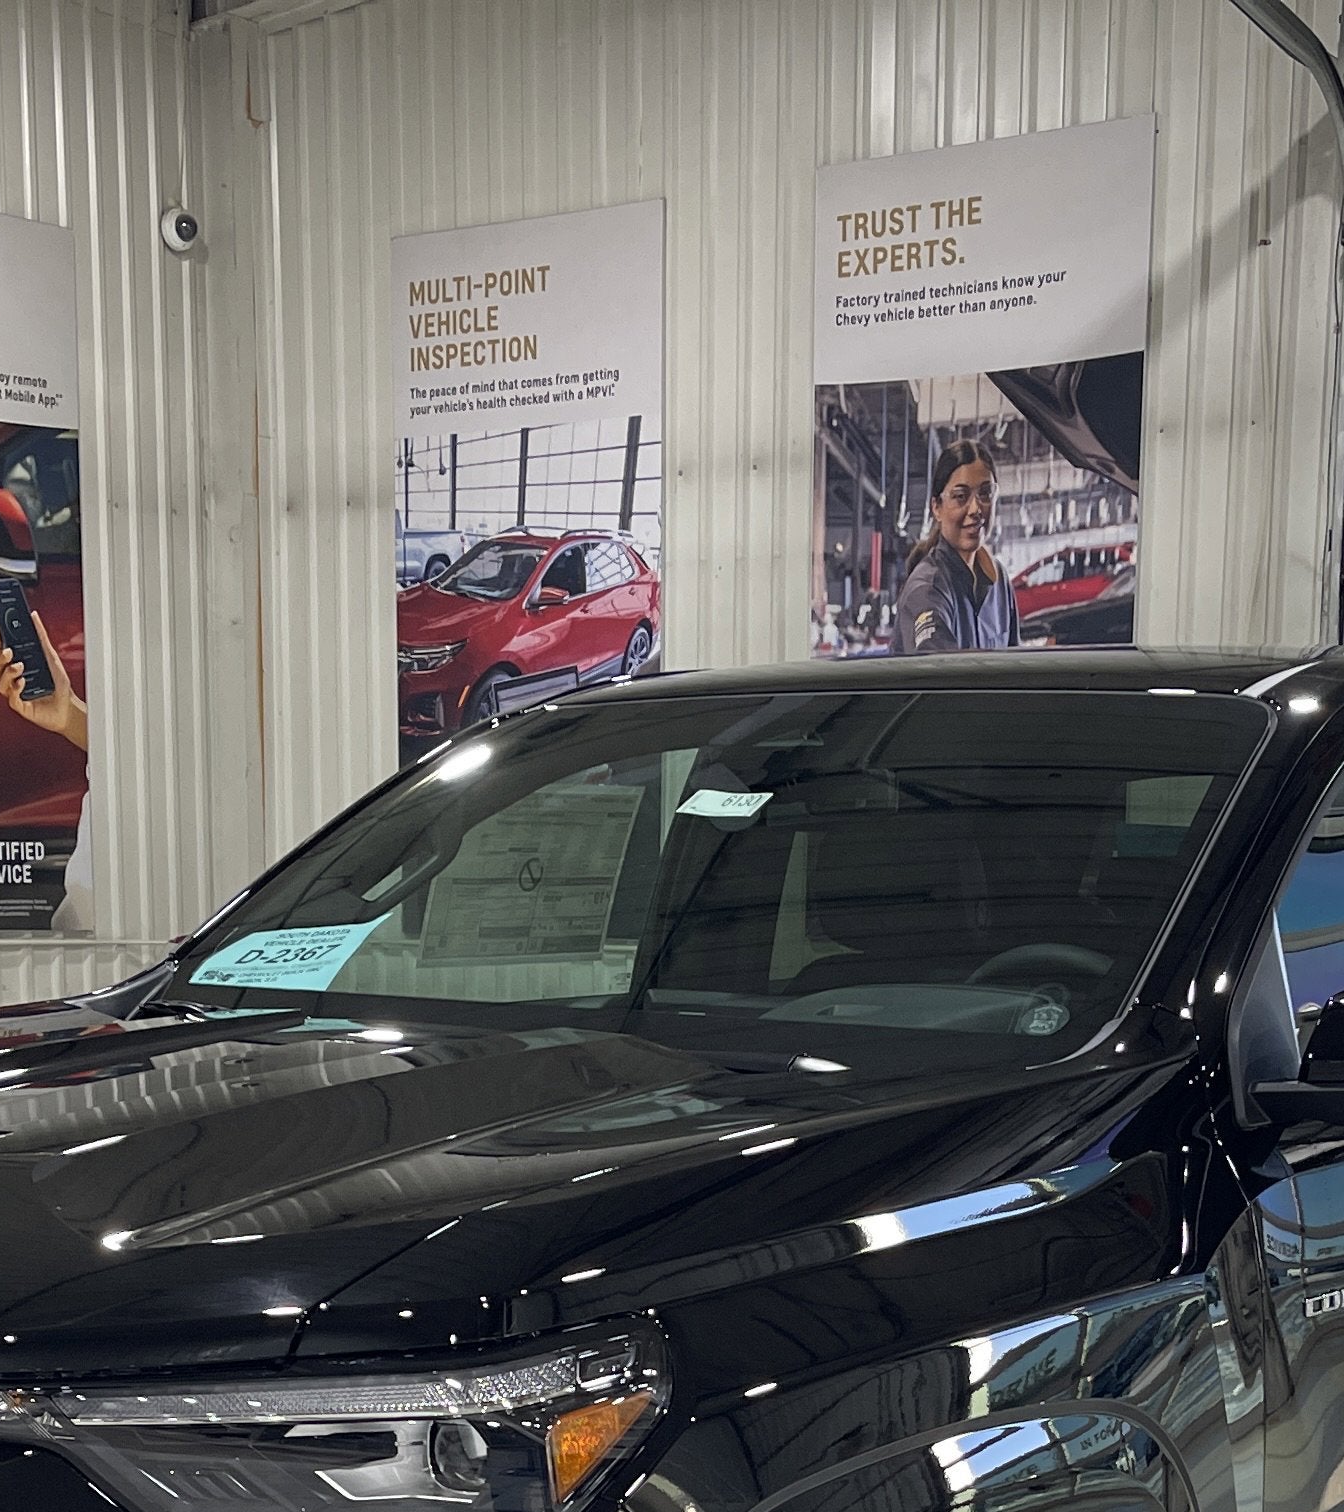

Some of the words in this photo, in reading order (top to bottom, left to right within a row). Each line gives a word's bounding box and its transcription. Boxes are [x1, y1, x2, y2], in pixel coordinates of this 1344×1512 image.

[837, 204, 922, 242] TRUST
[930, 196, 983, 230] THE
[837, 237, 966, 278] EXPERTS.
[409, 265, 550, 306] MULTI-POINT
[836, 293, 881, 309] Factory
[884, 286, 926, 303] trained
[929, 279, 998, 300] technicians
[1002, 274, 1034, 290] know
[1037, 270, 1067, 286] your
[409, 305, 499, 339] VEHICLE
[835, 309, 870, 327] Chevy
[874, 304, 914, 323] vehicle
[918, 301, 956, 318] better
[959, 298, 986, 314] than
[990, 294, 1037, 314] anyone.
[410, 334, 538, 372] INSPECTION
[5, 388, 36, 404] Mobile
[13, 373, 47, 389] remote
[410, 387, 427, 400] The
[429, 385, 457, 401] peace
[459, 382, 469, 395] of
[471, 379, 495, 394] mind
[498, 378, 518, 390] that
[521, 376, 553, 388] comes
[555, 372, 580, 386] from
[582, 368, 619, 384] getting
[410, 405, 430, 419] your
[433, 396, 474, 414] vehicle's
[476, 395, 507, 410] health
[509, 392, 550, 407] checked
[552, 389, 575, 403] with
[234, 944, 342, 965] D-2367
